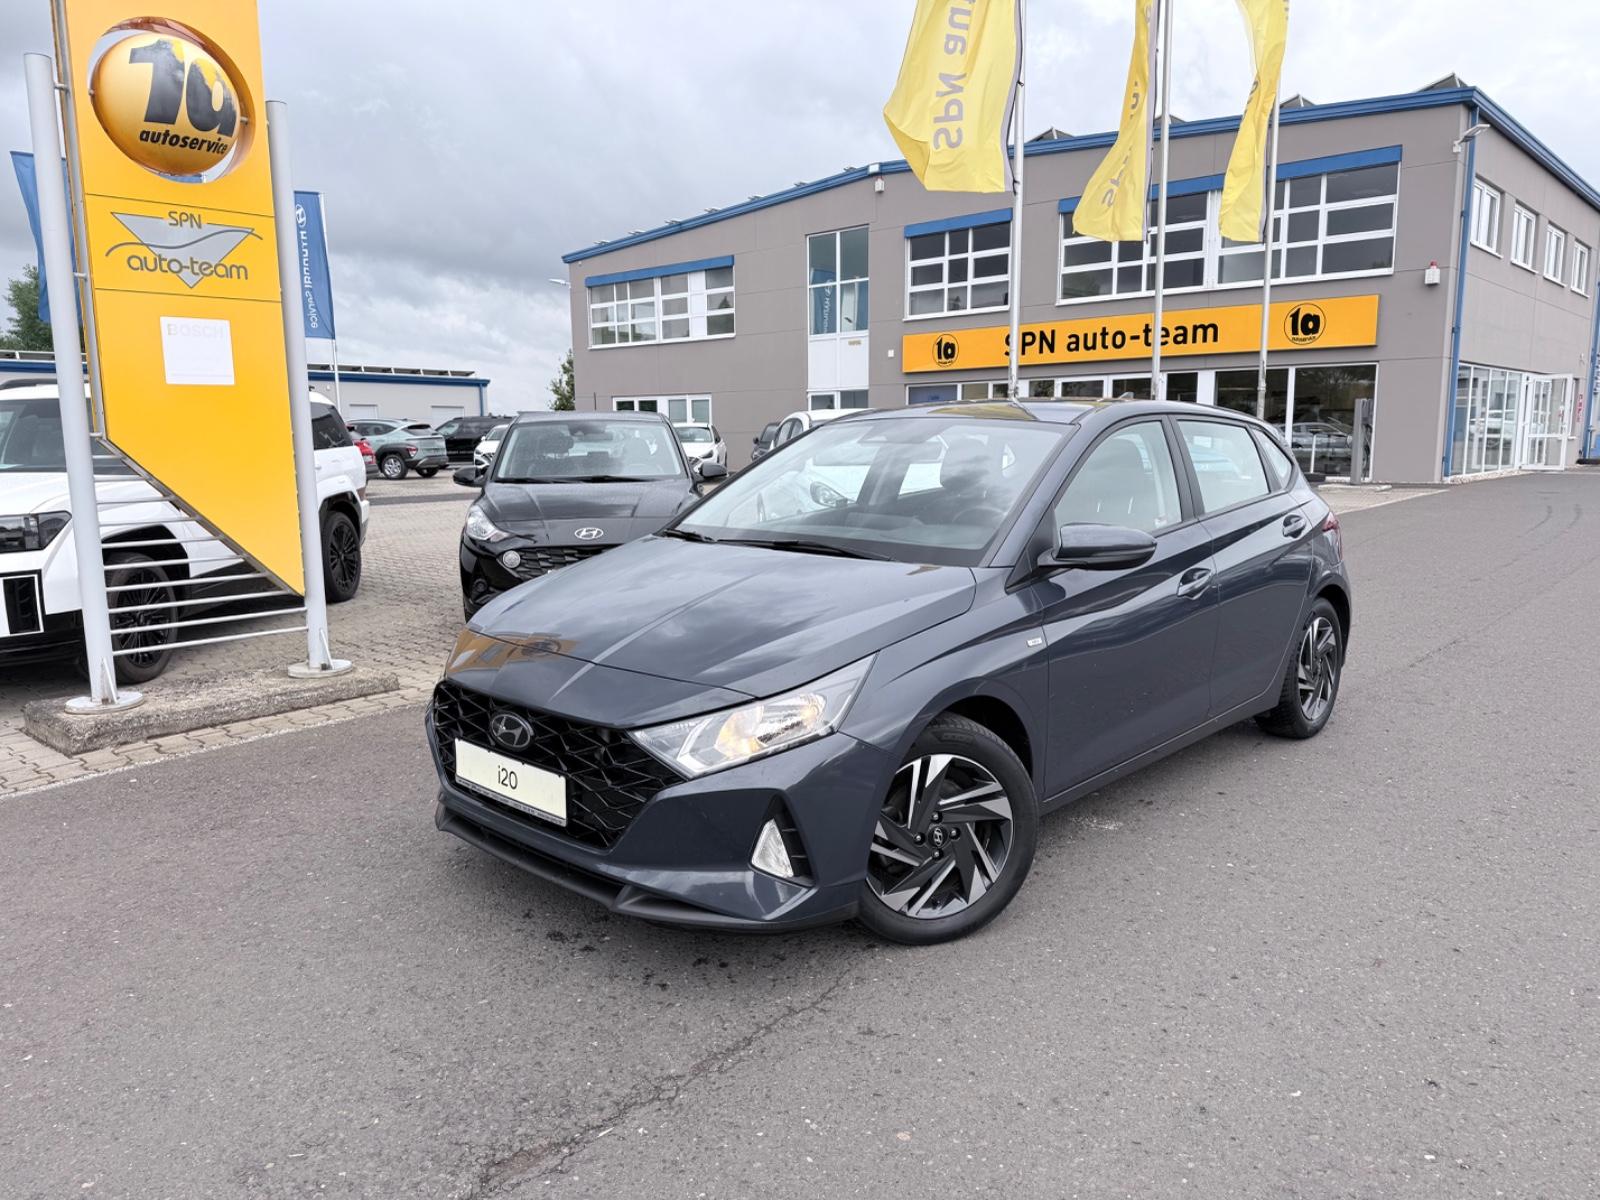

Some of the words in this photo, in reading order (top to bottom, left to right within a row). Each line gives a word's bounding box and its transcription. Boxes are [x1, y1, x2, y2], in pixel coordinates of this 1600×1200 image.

[139, 130, 228, 154] autoservice
[168, 210, 203, 229] SPN
[127, 254, 248, 280] auto-team
[166, 323, 224, 339] BOSCH
[1290, 307, 1321, 336] 1a
[936, 337, 956, 360] 1a
[1066, 322, 1219, 352] auto-team
[497, 765, 518, 790] i20
